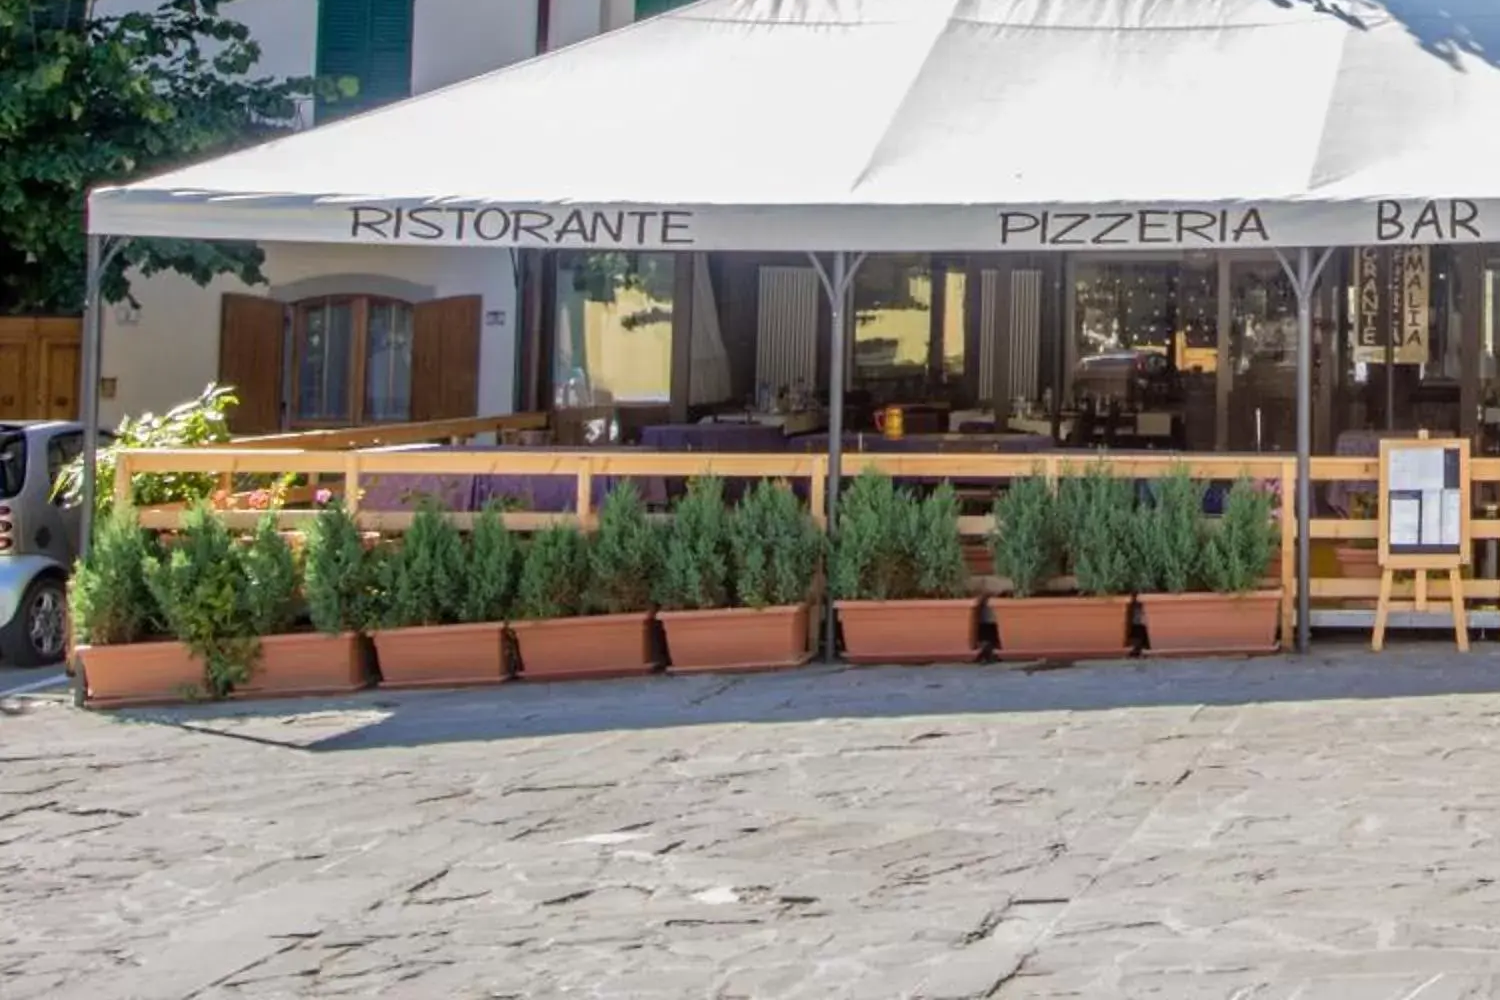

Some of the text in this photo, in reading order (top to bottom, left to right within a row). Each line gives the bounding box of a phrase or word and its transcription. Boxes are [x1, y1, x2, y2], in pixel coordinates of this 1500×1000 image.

[348, 205, 694, 245] RISTORANTE
[1001, 207, 1269, 244] PIZZERIA
[1376, 199, 1481, 241] BAR
